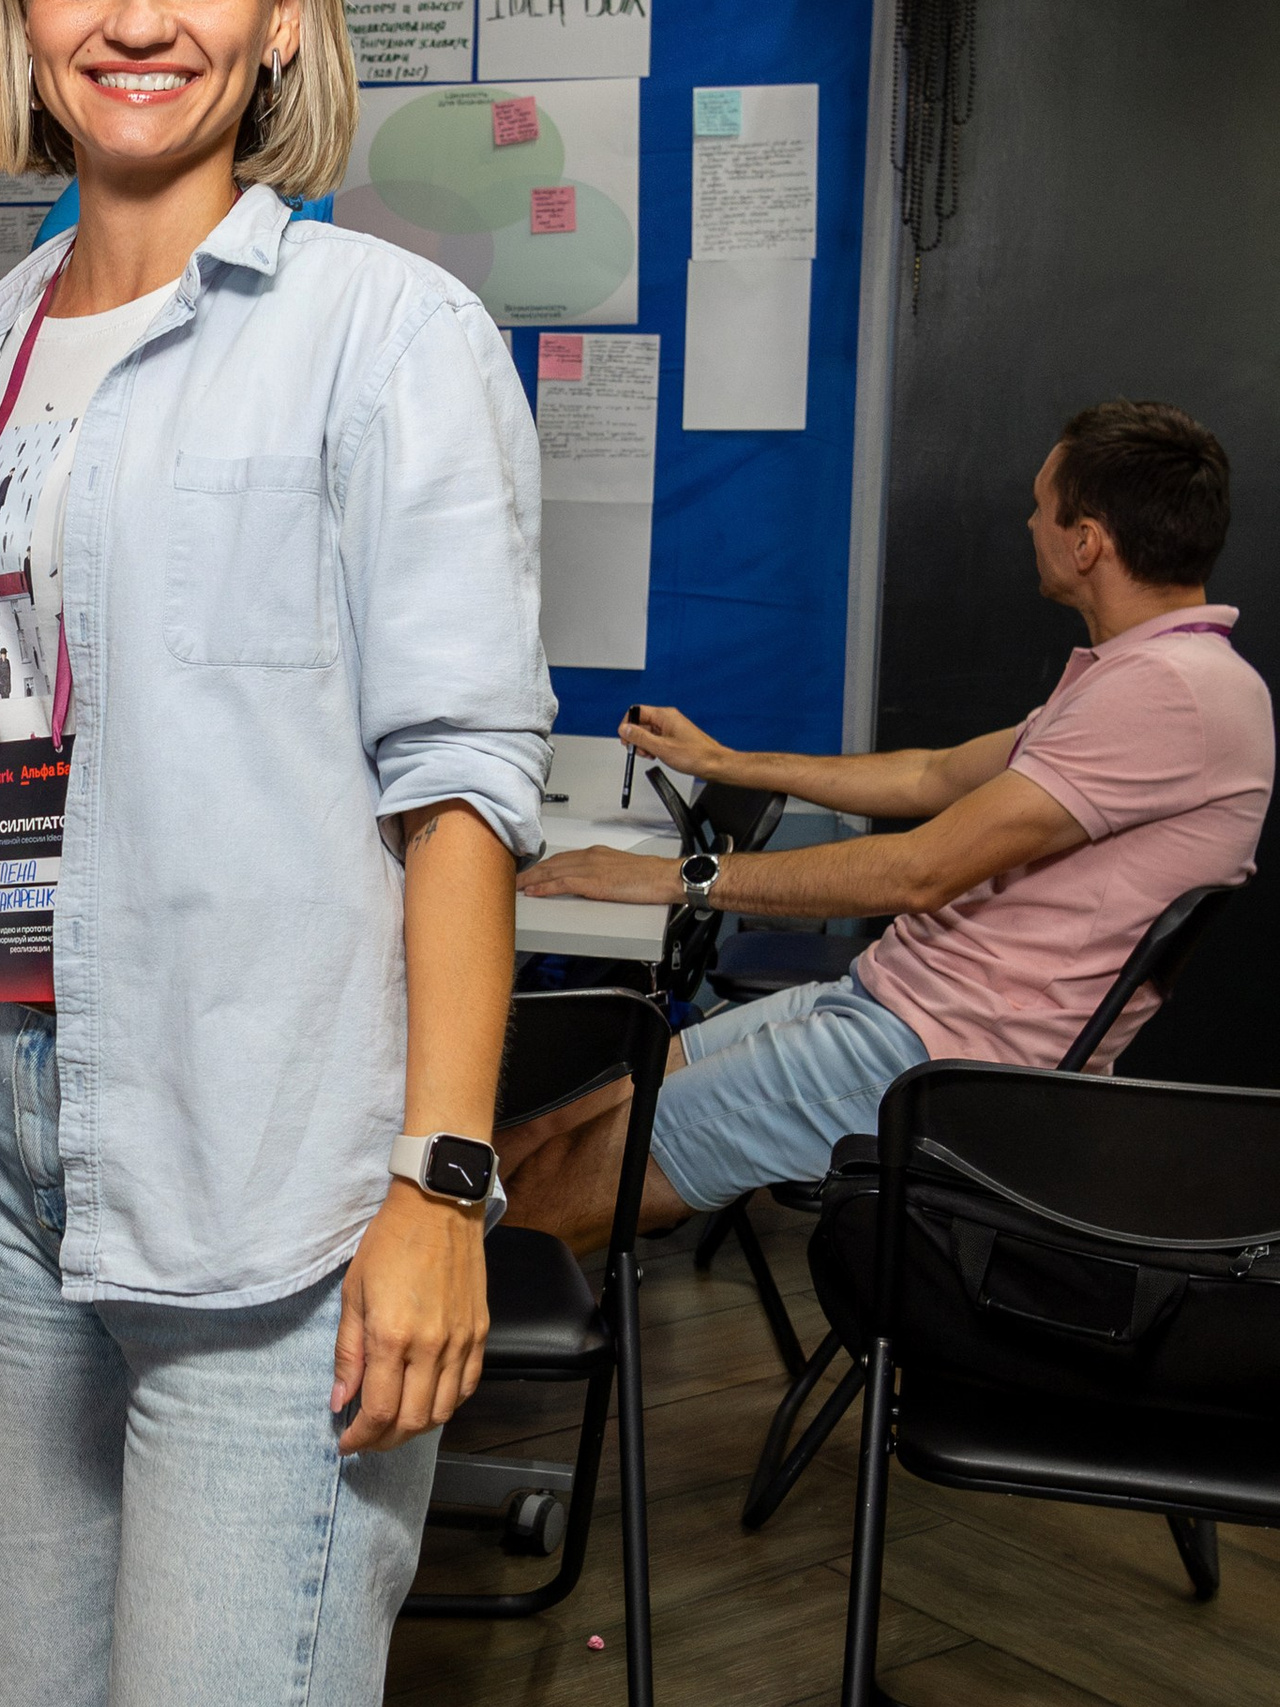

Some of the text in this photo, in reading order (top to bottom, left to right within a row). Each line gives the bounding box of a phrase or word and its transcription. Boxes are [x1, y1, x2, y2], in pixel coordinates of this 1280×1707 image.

[20, 763, 55, 784] Альфа
[21, 836, 46, 845] сессии
[0, 927, 16, 935] идею
[10, 946, 51, 955] реализации
